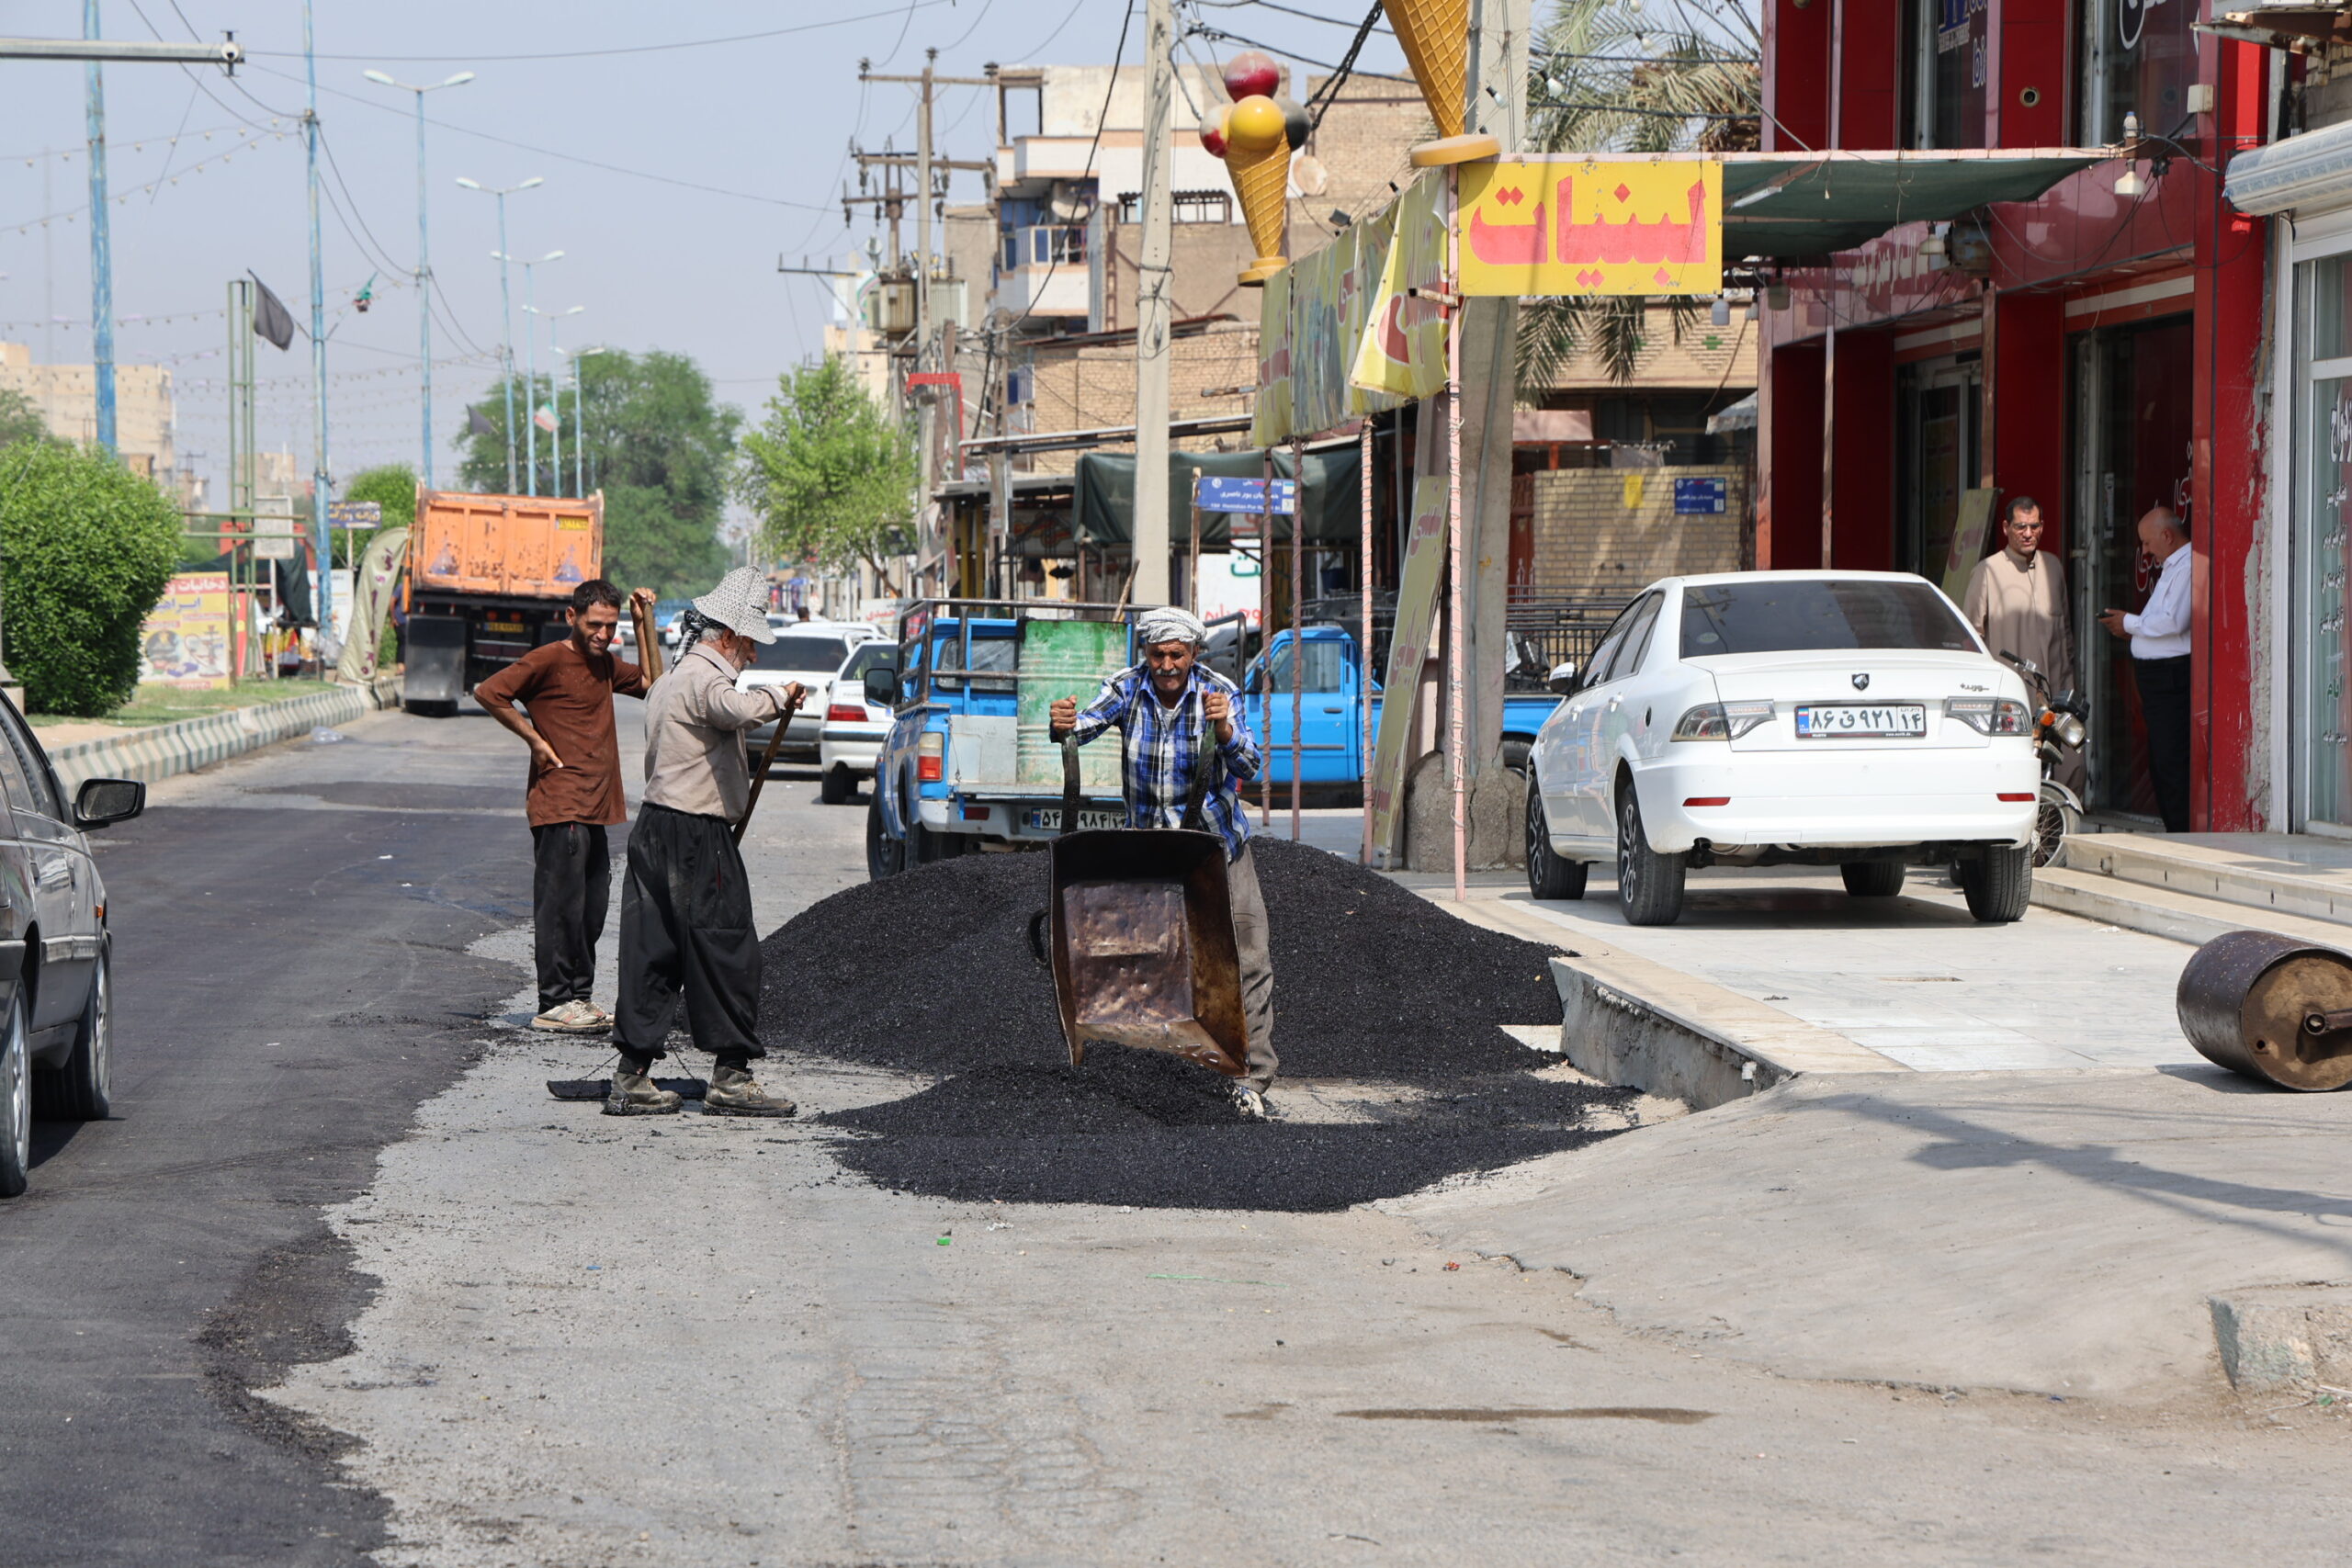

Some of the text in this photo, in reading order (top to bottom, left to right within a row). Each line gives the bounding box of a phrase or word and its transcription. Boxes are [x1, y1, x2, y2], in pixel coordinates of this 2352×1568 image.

[1470, 175, 1706, 288] لبنیات
[178, 578, 224, 593] دخانیات
[1901, 714, 1922, 729] ۱۴
[1042, 811, 1060, 827] ۵۴
